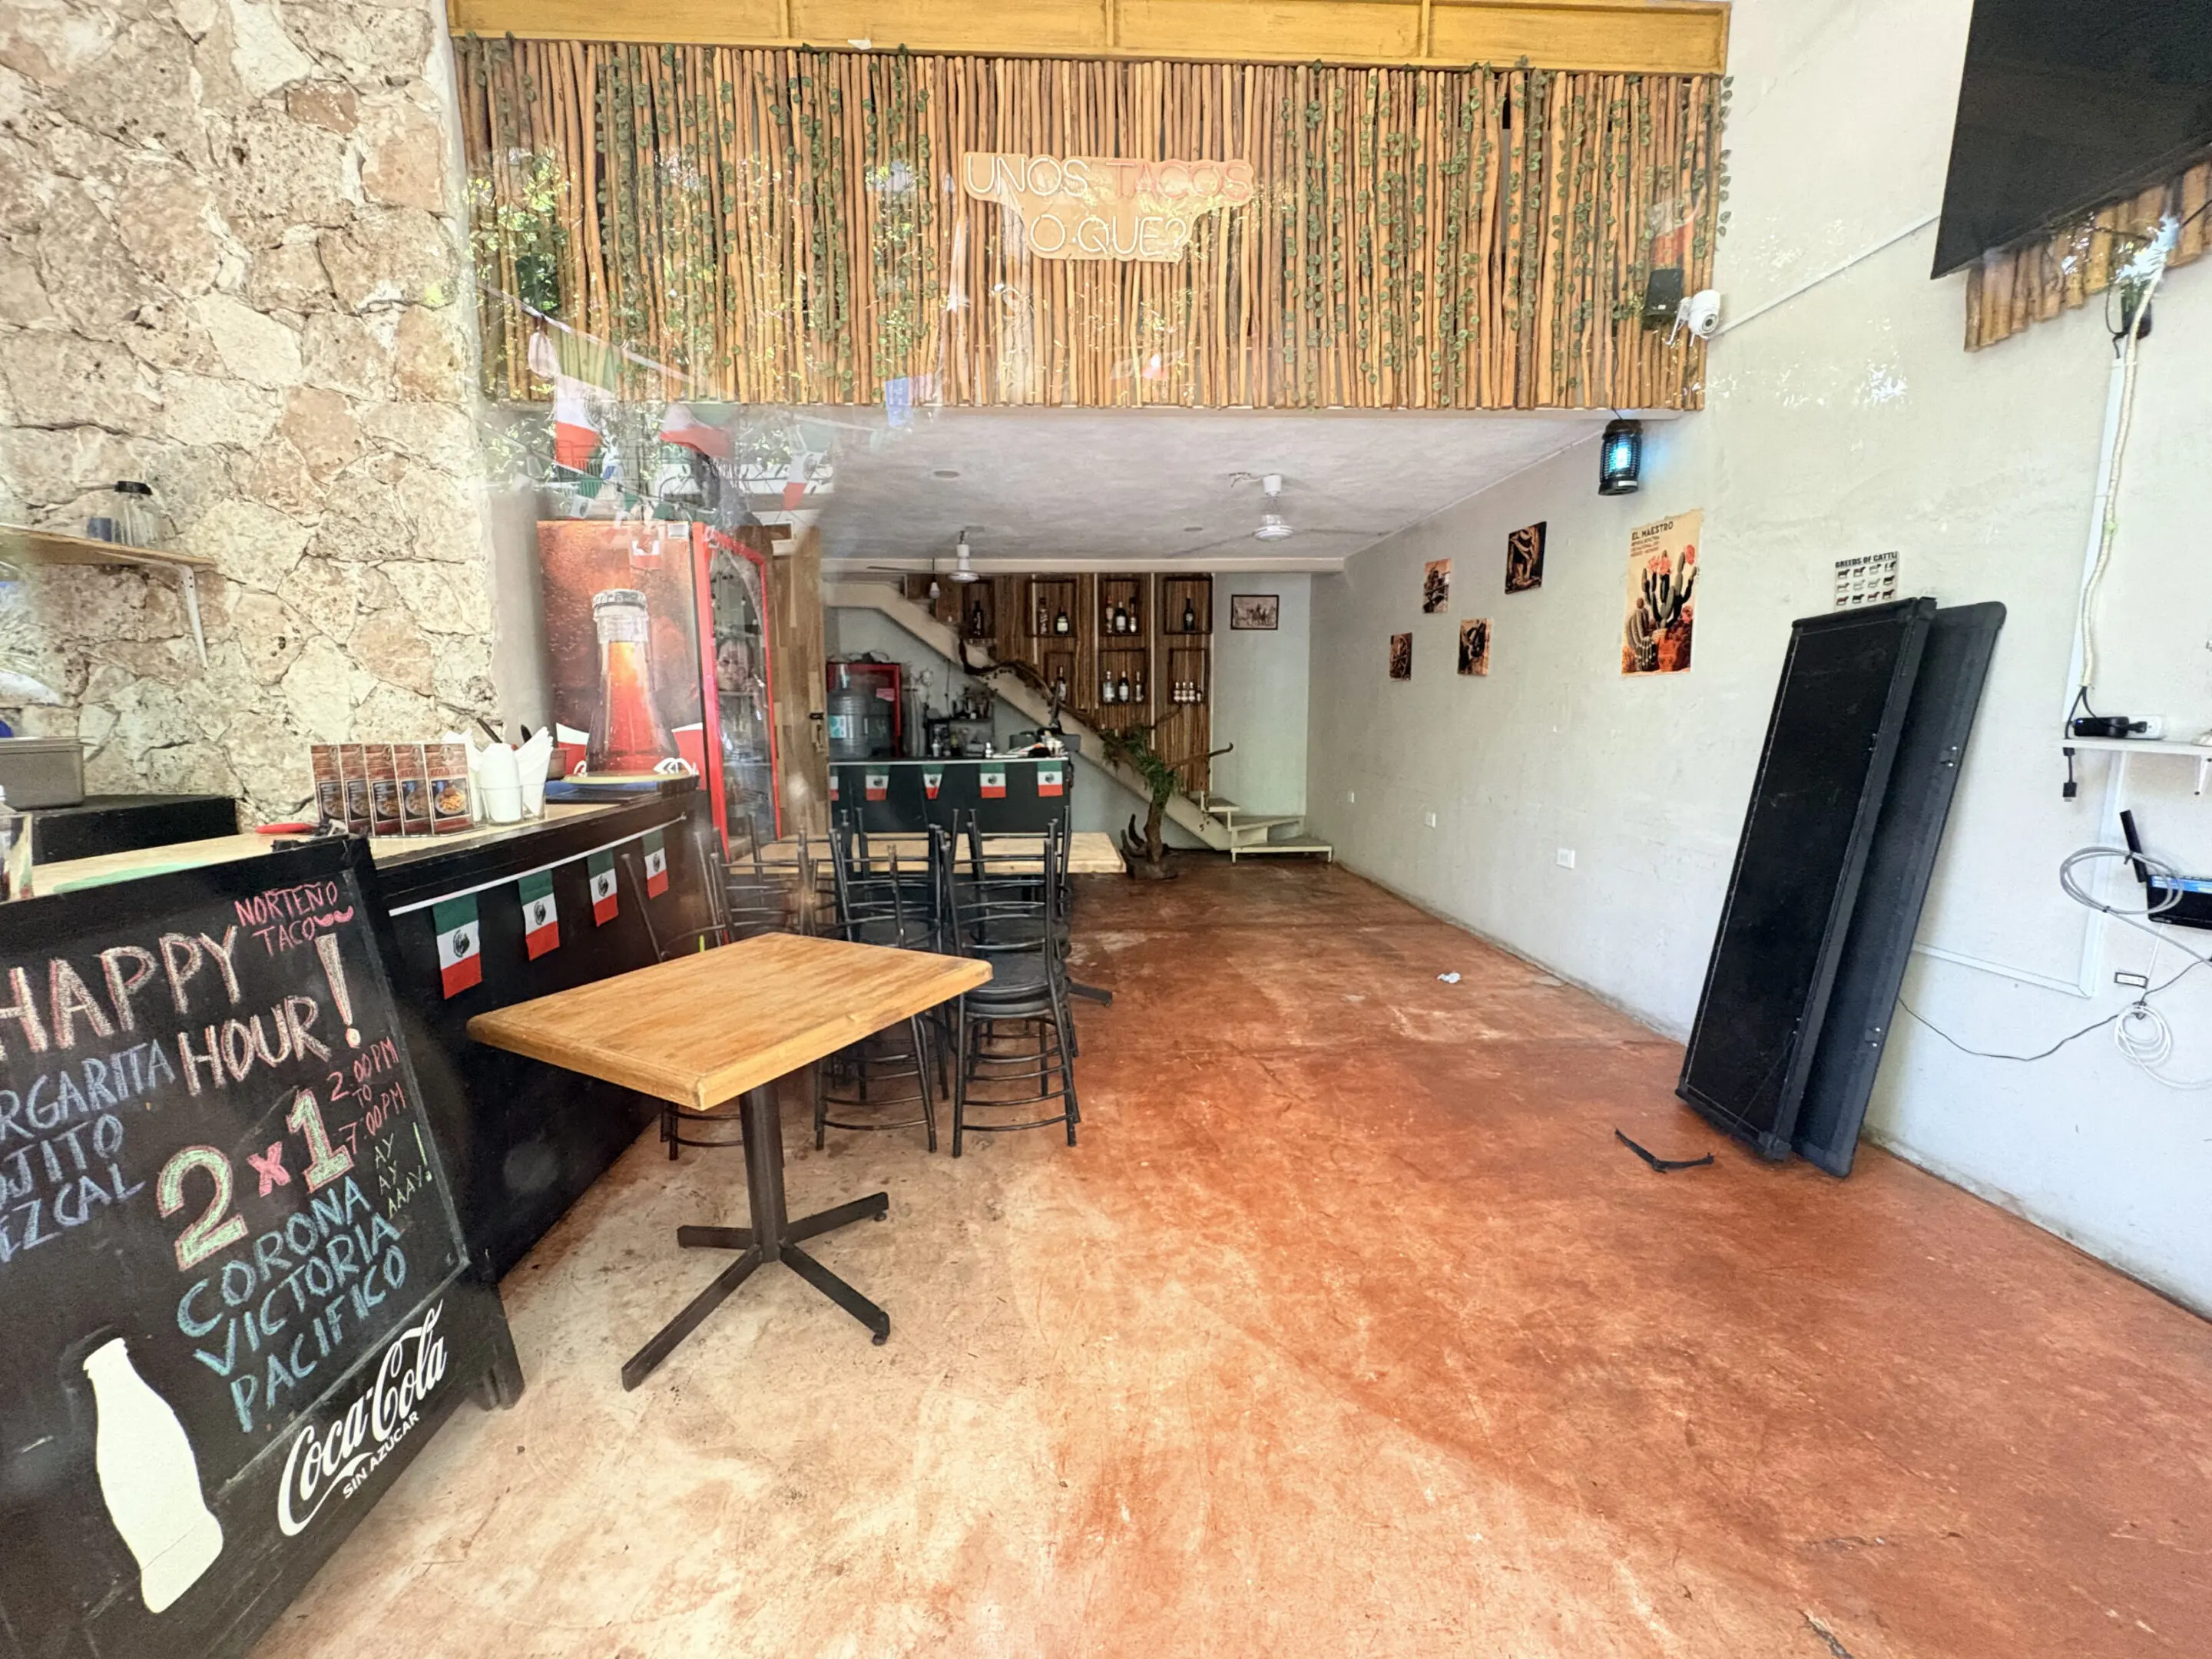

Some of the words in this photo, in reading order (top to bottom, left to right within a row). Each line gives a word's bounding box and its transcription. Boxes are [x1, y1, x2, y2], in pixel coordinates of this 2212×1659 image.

[967, 154, 1090, 198] UNOS
[1105, 158, 1252, 202] TACOS
[1030, 214, 1066, 252] O
[1077, 216, 1187, 258] QUE?
[1631, 531, 1640, 541] EL
[1641, 521, 1674, 538] MAESTRO
[1835, 558, 1862, 568] BREEDS
[1863, 555, 1871, 564] OF
[251, 916, 316, 957] TACO
[0, 925, 241, 1061] HAPPY
[351, 1084, 372, 1108] TO
[0, 1114, 124, 1210] JITO
[375, 1133, 394, 1169] AY
[157, 1145, 250, 1272] 2
[285, 1088, 356, 1192] 1
[379, 1160, 397, 1195] AY
[177, 1177, 372, 1337] CORONA
[193, 1212, 402, 1376] VICTORIA
[230, 1244, 406, 1432] PACIFICO
[277, 1298, 448, 1536] Coca-Cola
[343, 1467, 369, 1499] SIN
